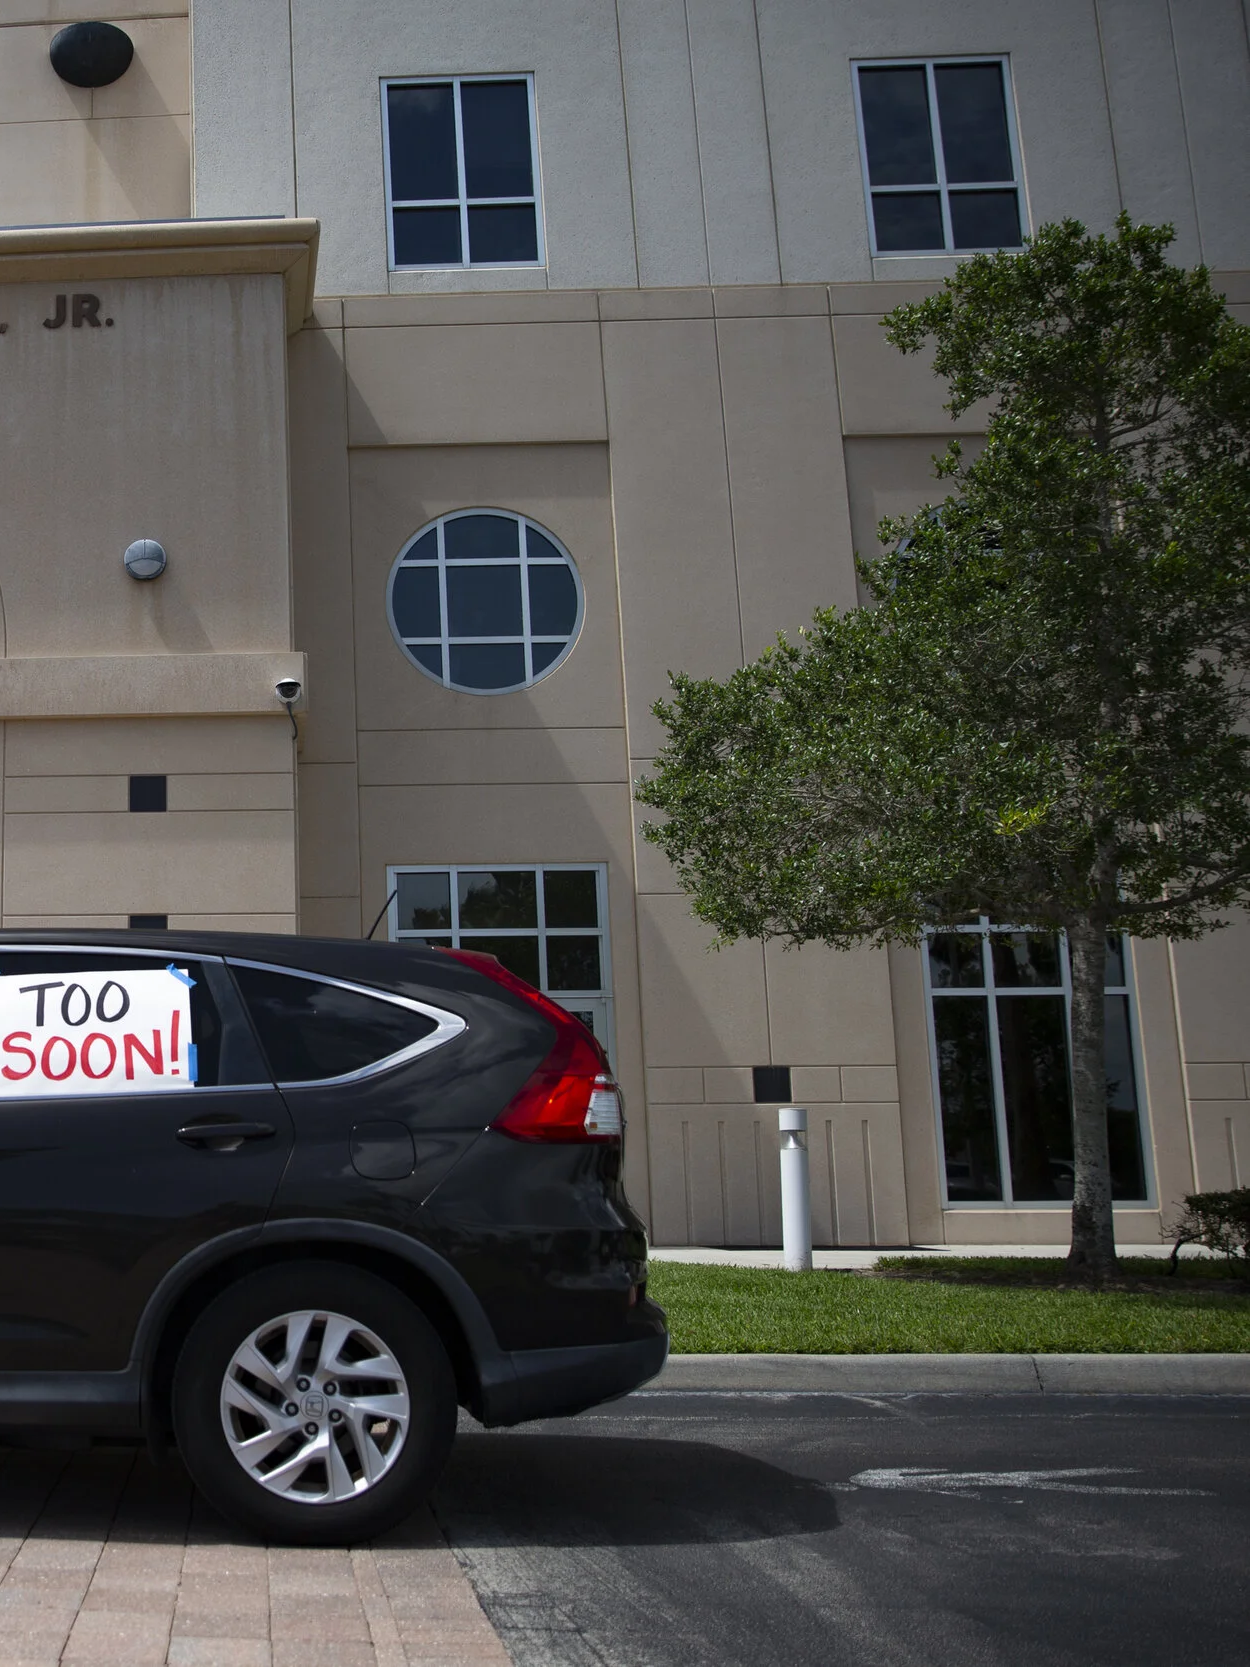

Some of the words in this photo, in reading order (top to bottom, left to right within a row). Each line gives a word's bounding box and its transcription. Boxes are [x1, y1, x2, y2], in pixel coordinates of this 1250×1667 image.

[42, 293, 114, 329] JR.
[19, 980, 131, 1027] TOO
[1, 1010, 180, 1081] SOON!
